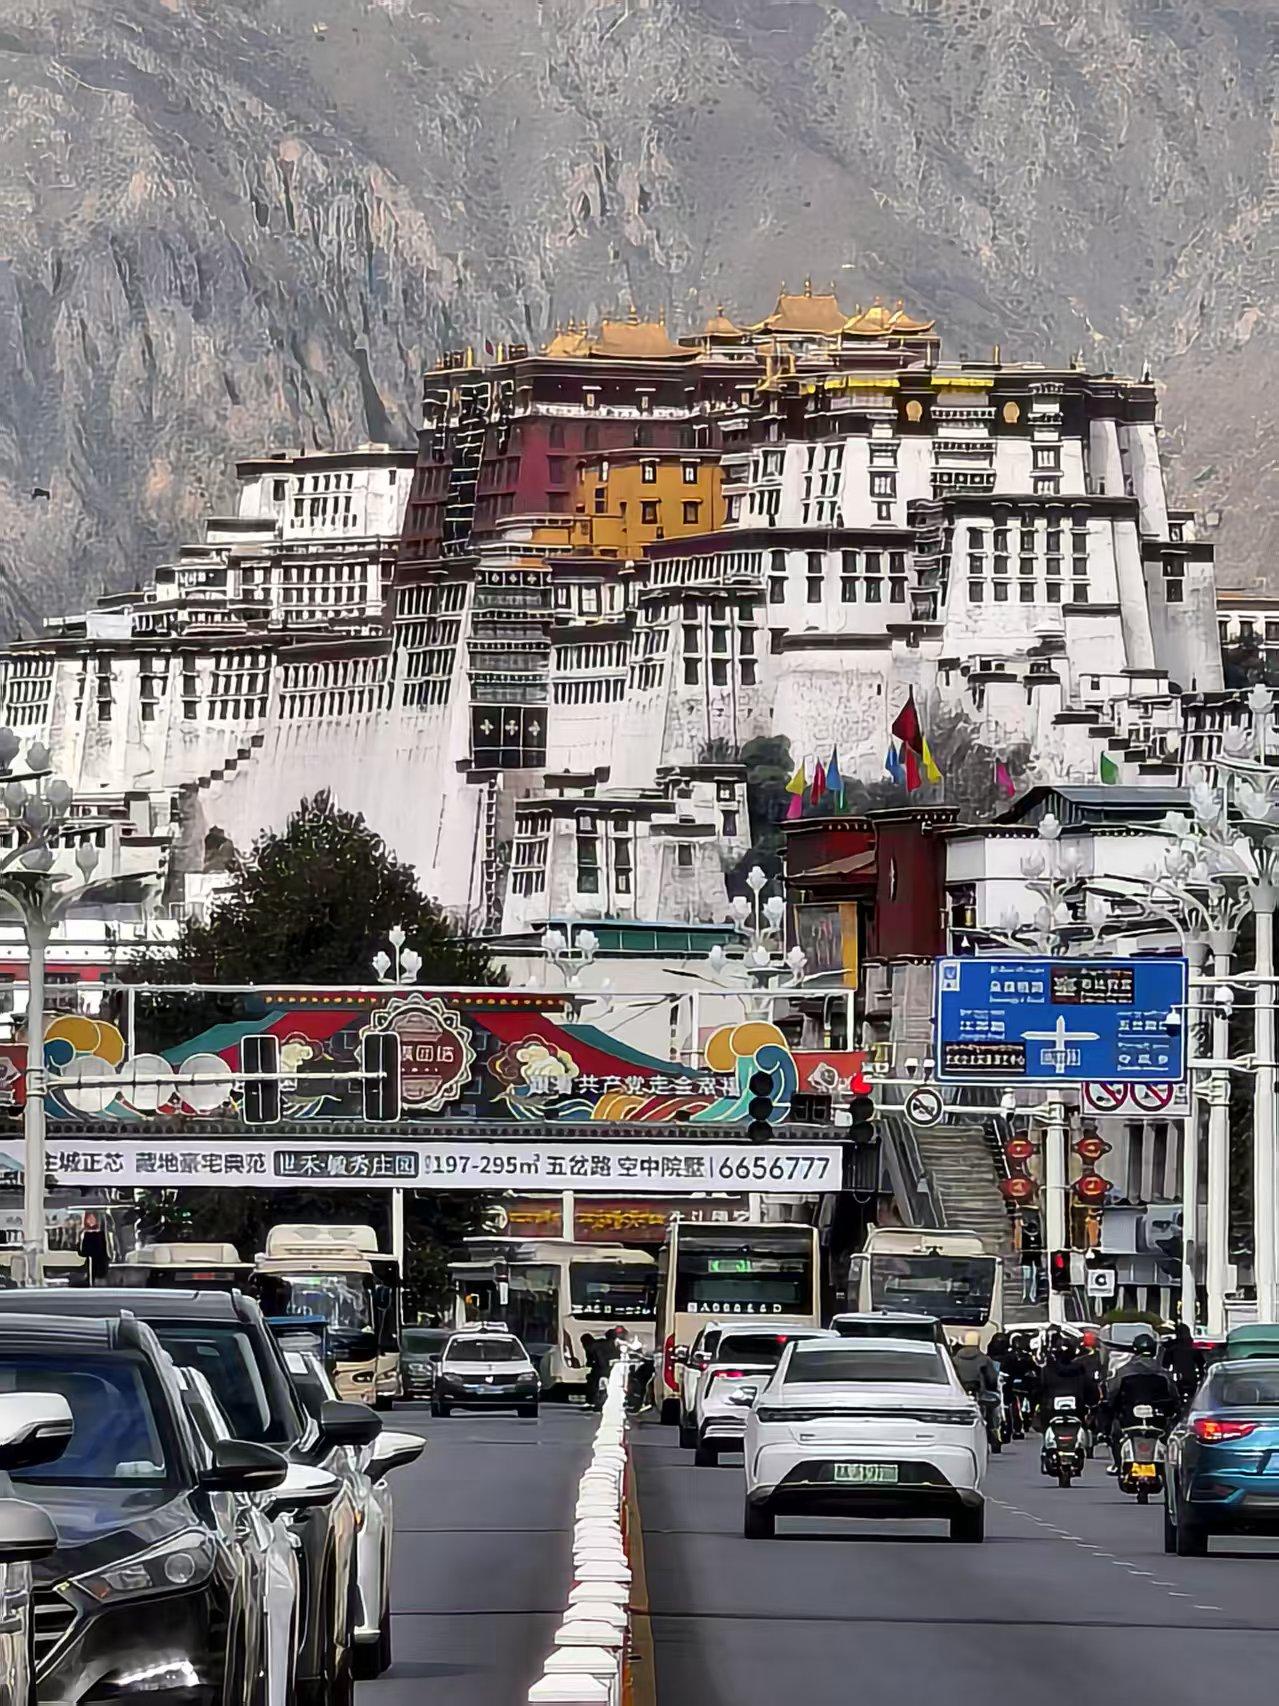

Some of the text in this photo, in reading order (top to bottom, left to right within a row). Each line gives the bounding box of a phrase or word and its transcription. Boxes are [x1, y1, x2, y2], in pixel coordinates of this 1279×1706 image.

[546, 1155, 612, 1177] 五岔路
[718, 1157, 831, 1180] 6656777
